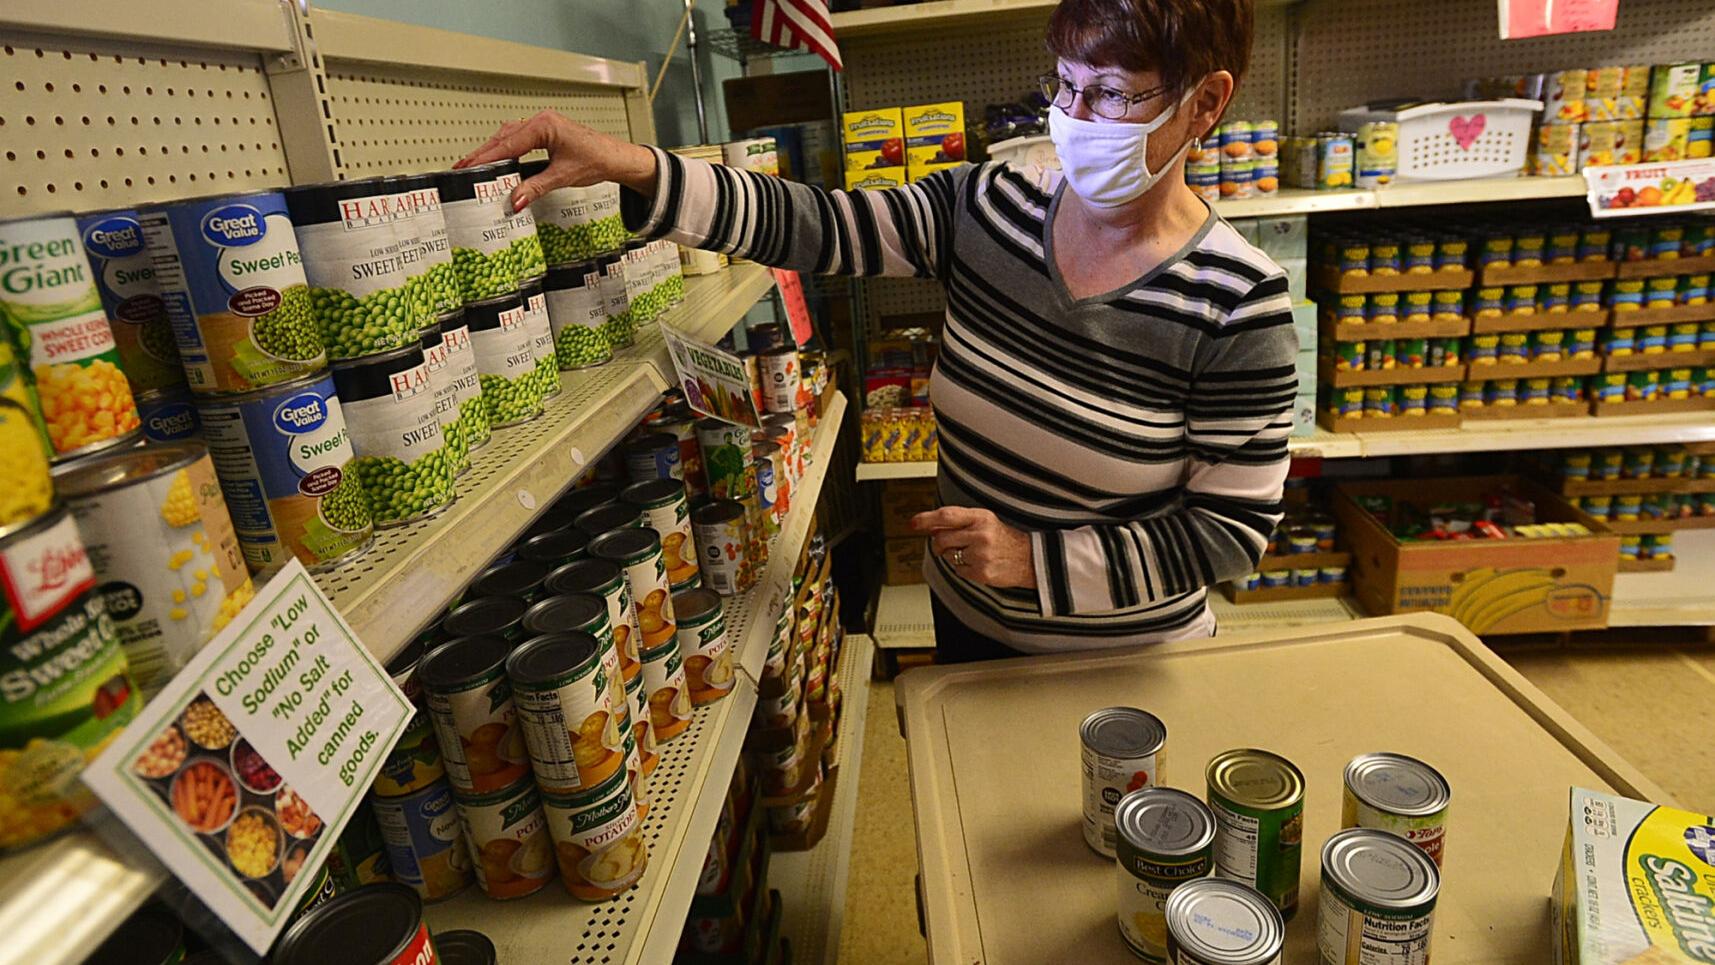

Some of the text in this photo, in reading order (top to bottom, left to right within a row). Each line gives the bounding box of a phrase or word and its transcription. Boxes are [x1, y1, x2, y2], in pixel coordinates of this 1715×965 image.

[1625, 168, 1668, 179] FRUIT
[209, 213, 257, 232] Great
[223, 227, 260, 240] Value
[91, 226, 137, 244] Great
[105, 239, 139, 251] Value
[230, 255, 285, 276] Sweet
[351, 256, 395, 280] SWEET
[1, 263, 84, 294] Giant
[45, 336, 90, 358] SWEET
[686, 345, 745, 382] VEGETABLES
[150, 410, 193, 430] Great
[280, 400, 321, 422] Great
[293, 412, 323, 427] Value
[162, 421, 195, 436] Value
[402, 420, 439, 447] SWEET
[300, 432, 342, 460] Sweet
[215, 594, 309, 697] Choose "Low
[0, 624, 103, 700] Sweet
[241, 623, 321, 715] Sodium" or
[272, 653, 331, 720] "No Salt
[536, 692, 558, 700] Facts
[285, 669, 354, 760] Added" for
[317, 699, 364, 766] canned
[338, 729, 381, 787] goods.
[1137, 859, 1205, 876] Best Choice
[1631, 875, 1661, 929] crackers
[1646, 856, 1715, 962] Saltine
[1364, 916, 1408, 932] Nutrition
[1361, 941, 1388, 954] Calories
